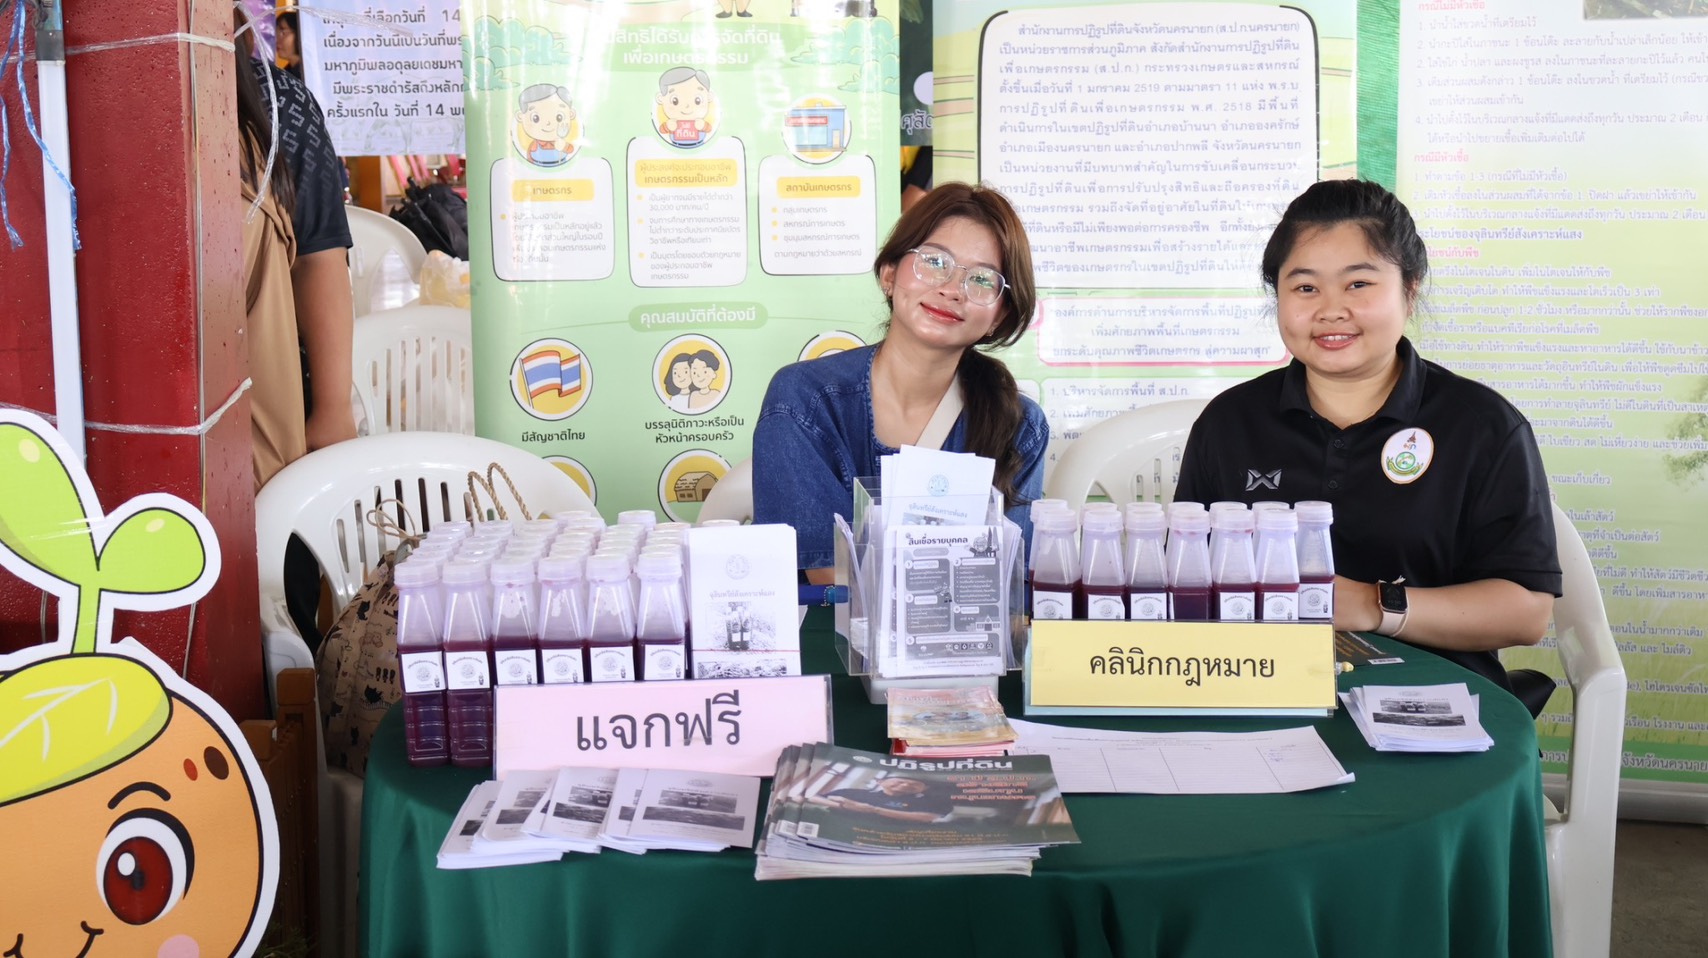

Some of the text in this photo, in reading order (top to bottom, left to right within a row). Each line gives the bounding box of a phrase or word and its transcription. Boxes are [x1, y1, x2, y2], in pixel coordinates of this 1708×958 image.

[442, 9, 461, 23] 14
[1087, 83, 1131, 94] มกราคม
[1134, 82, 1160, 93] 2519
[1226, 81, 1238, 93] 11
[395, 100, 419, 118] วันที่
[426, 103, 445, 117] 14
[1222, 101, 1252, 112] 2518
[1669, 112, 1677, 124] 2
[1671, 208, 1679, 220] 2
[640, 306, 757, 329] คุณสมบัติที่ต้องมี
[645, 416, 745, 431] บรรลุนิติภาวะหรือเป็น
[521, 428, 586, 443] มีสัญชาติไทย
[655, 430, 735, 445] หัวหน้าครอบครัว
[1089, 646, 1275, 687] คลินิกกฎหมาย
[576, 689, 742, 751] แจกฟรี
